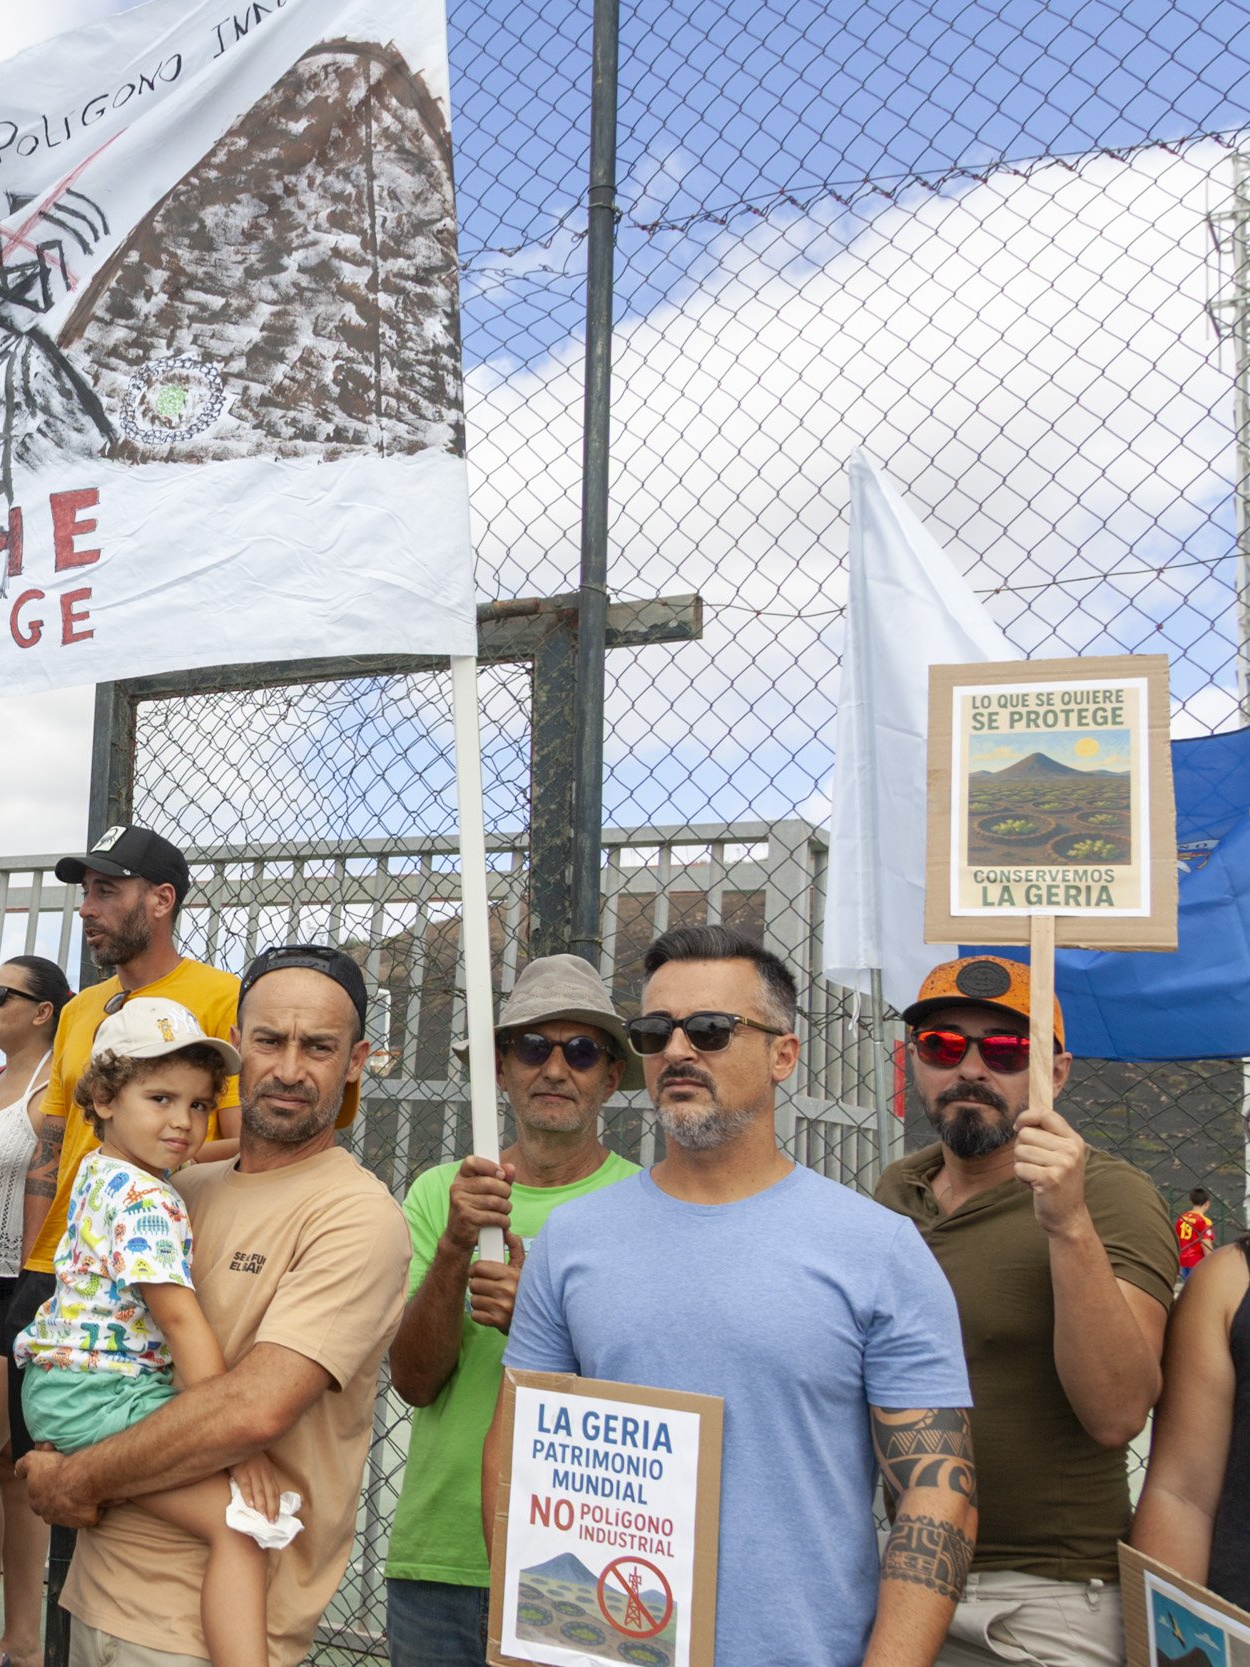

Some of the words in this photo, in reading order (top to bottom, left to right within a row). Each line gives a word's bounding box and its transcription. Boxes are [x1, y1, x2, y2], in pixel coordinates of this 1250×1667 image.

[972, 696, 991, 709] LO
[997, 694, 1030, 709] QUE
[1035, 692, 1055, 707] SE
[971, 711, 1000, 731] SE
[1009, 707, 1124, 729] PROTEGE
[973, 869, 1115, 884] CONSERVEMOS
[982, 885, 1016, 907] LA
[1025, 884, 1115, 907] GERIA
[538, 1403, 572, 1437] LA
[582, 1411, 673, 1454] GERIA
[532, 1439, 663, 1480] PATRIMONIO
[552, 1468, 648, 1505] MUNDIAL
[529, 1494, 575, 1531] NO
[579, 1524, 674, 1558] INDUSTRIAL
